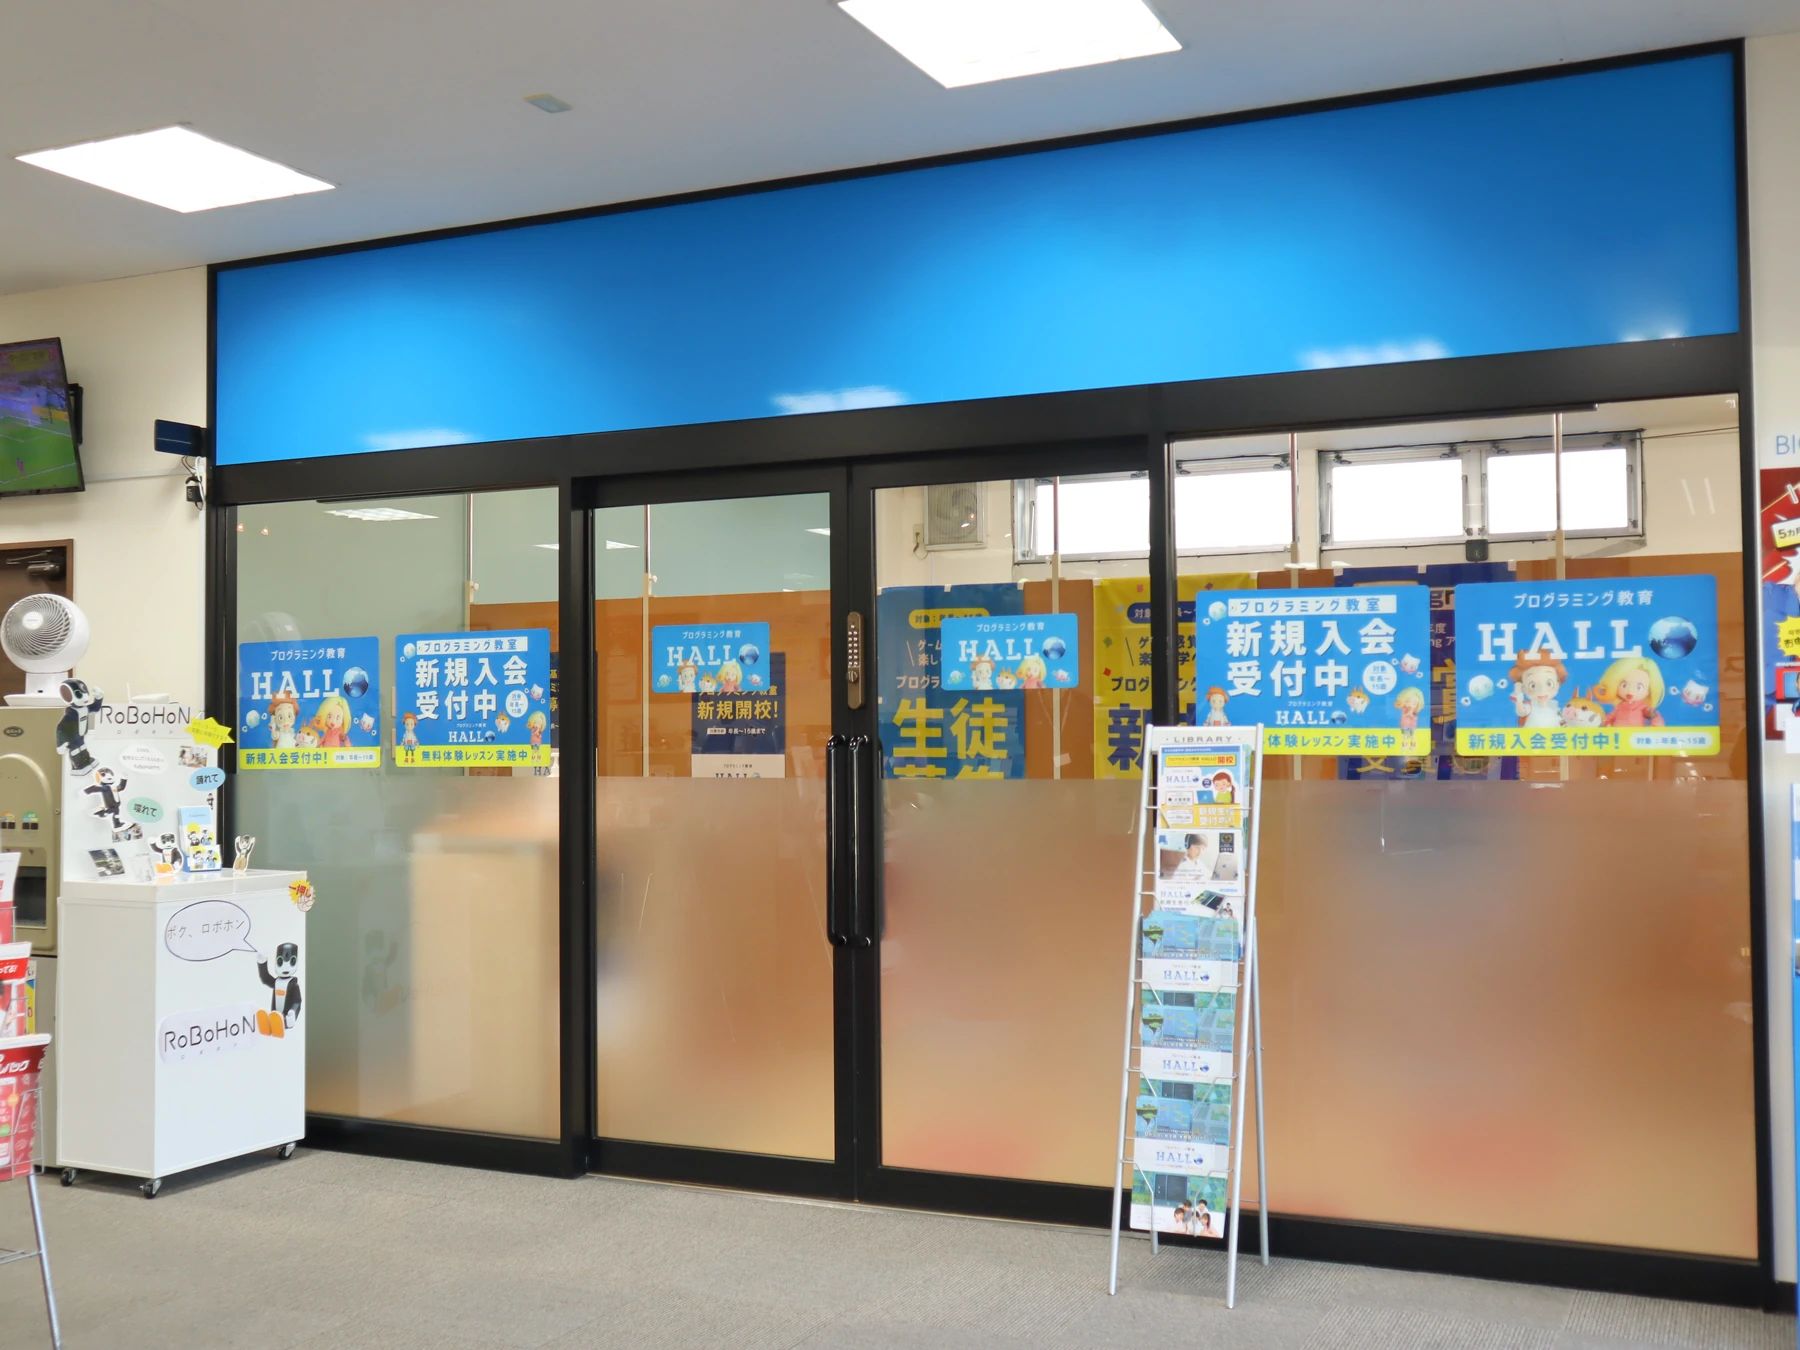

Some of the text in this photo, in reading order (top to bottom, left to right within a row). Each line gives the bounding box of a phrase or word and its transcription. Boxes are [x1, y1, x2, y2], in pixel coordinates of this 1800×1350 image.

[1776, 434, 1800, 456] BI
[1240, 598, 1381, 613] プログラミング教室
[1513, 590, 1654, 608] プログラミング教育
[424, 639, 518, 652] プログラミング教室
[1226, 618, 1397, 657] 新規入会
[271, 648, 346, 661] プログラミング教育
[415, 655, 528, 688] 新規入会
[1226, 659, 1350, 698] 受付中
[416, 689, 497, 720] 受付中
[697, 700, 778, 720] 新規開校!
[892, 697, 1008, 759] 生徒
[1173, 735, 1233, 744] LIBRARY
[1268, 734, 1396, 749] 体験レッスン実施中
[1468, 732, 1621, 750] 新規入会受付中!
[246, 751, 328, 766] 新規入会受付中!
[421, 749, 528, 762] 無料体験レッスン実施中
[164, 1014, 257, 1052] RoBoHoN
